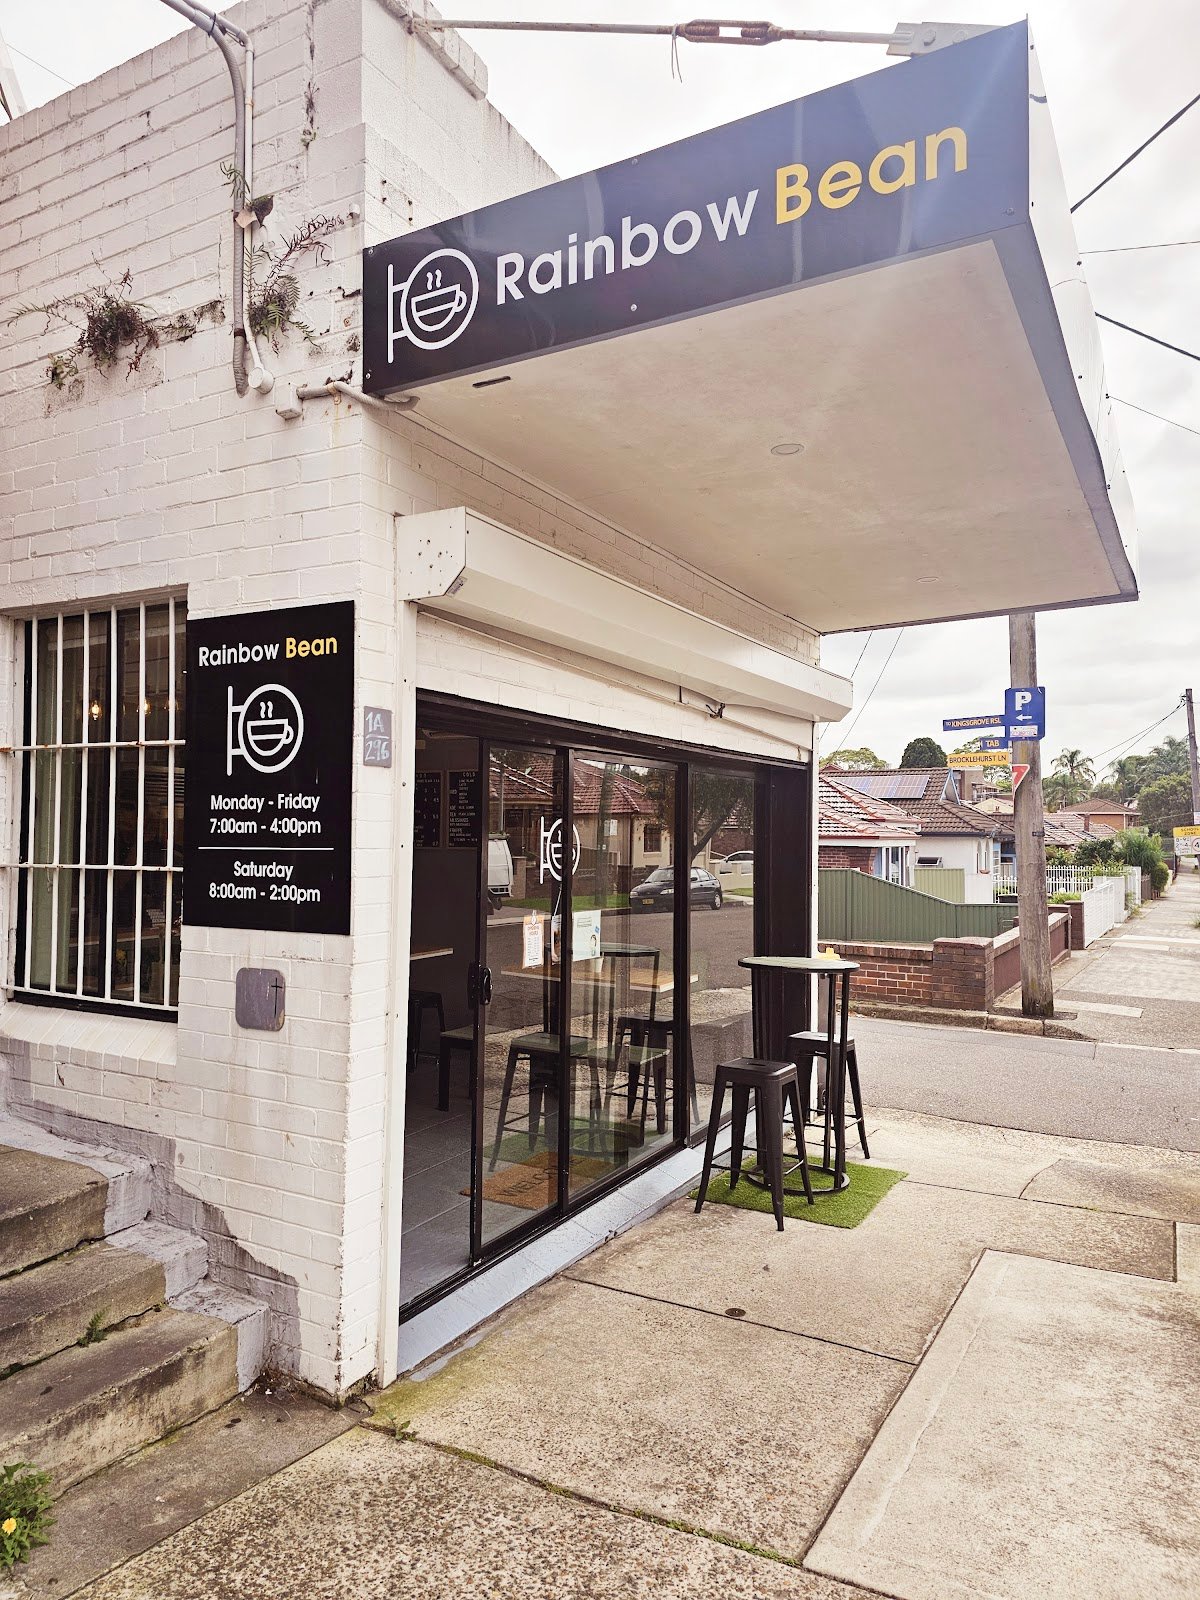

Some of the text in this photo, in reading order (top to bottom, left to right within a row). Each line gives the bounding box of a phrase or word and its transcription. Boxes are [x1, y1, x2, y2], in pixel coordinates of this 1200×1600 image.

[496, 126, 968, 306] Rainbow Bean
[198, 636, 338, 667] Rainbow Bean
[1015, 691, 1032, 711] P
[366, 711, 385, 733] 1A
[951, 718, 989, 727] KINGSGROVE
[365, 740, 390, 761] 296
[949, 755, 997, 764] BROCKLEHURST
[210, 794, 265, 814] Monday
[277, 792, 321, 813] Friday
[209, 817, 258, 834] 7:00am
[269, 817, 322, 837] 4:00pm
[233, 860, 294, 882] Saturday
[208, 882, 257, 900] 8:00am
[269, 883, 321, 905] 2:00pm
